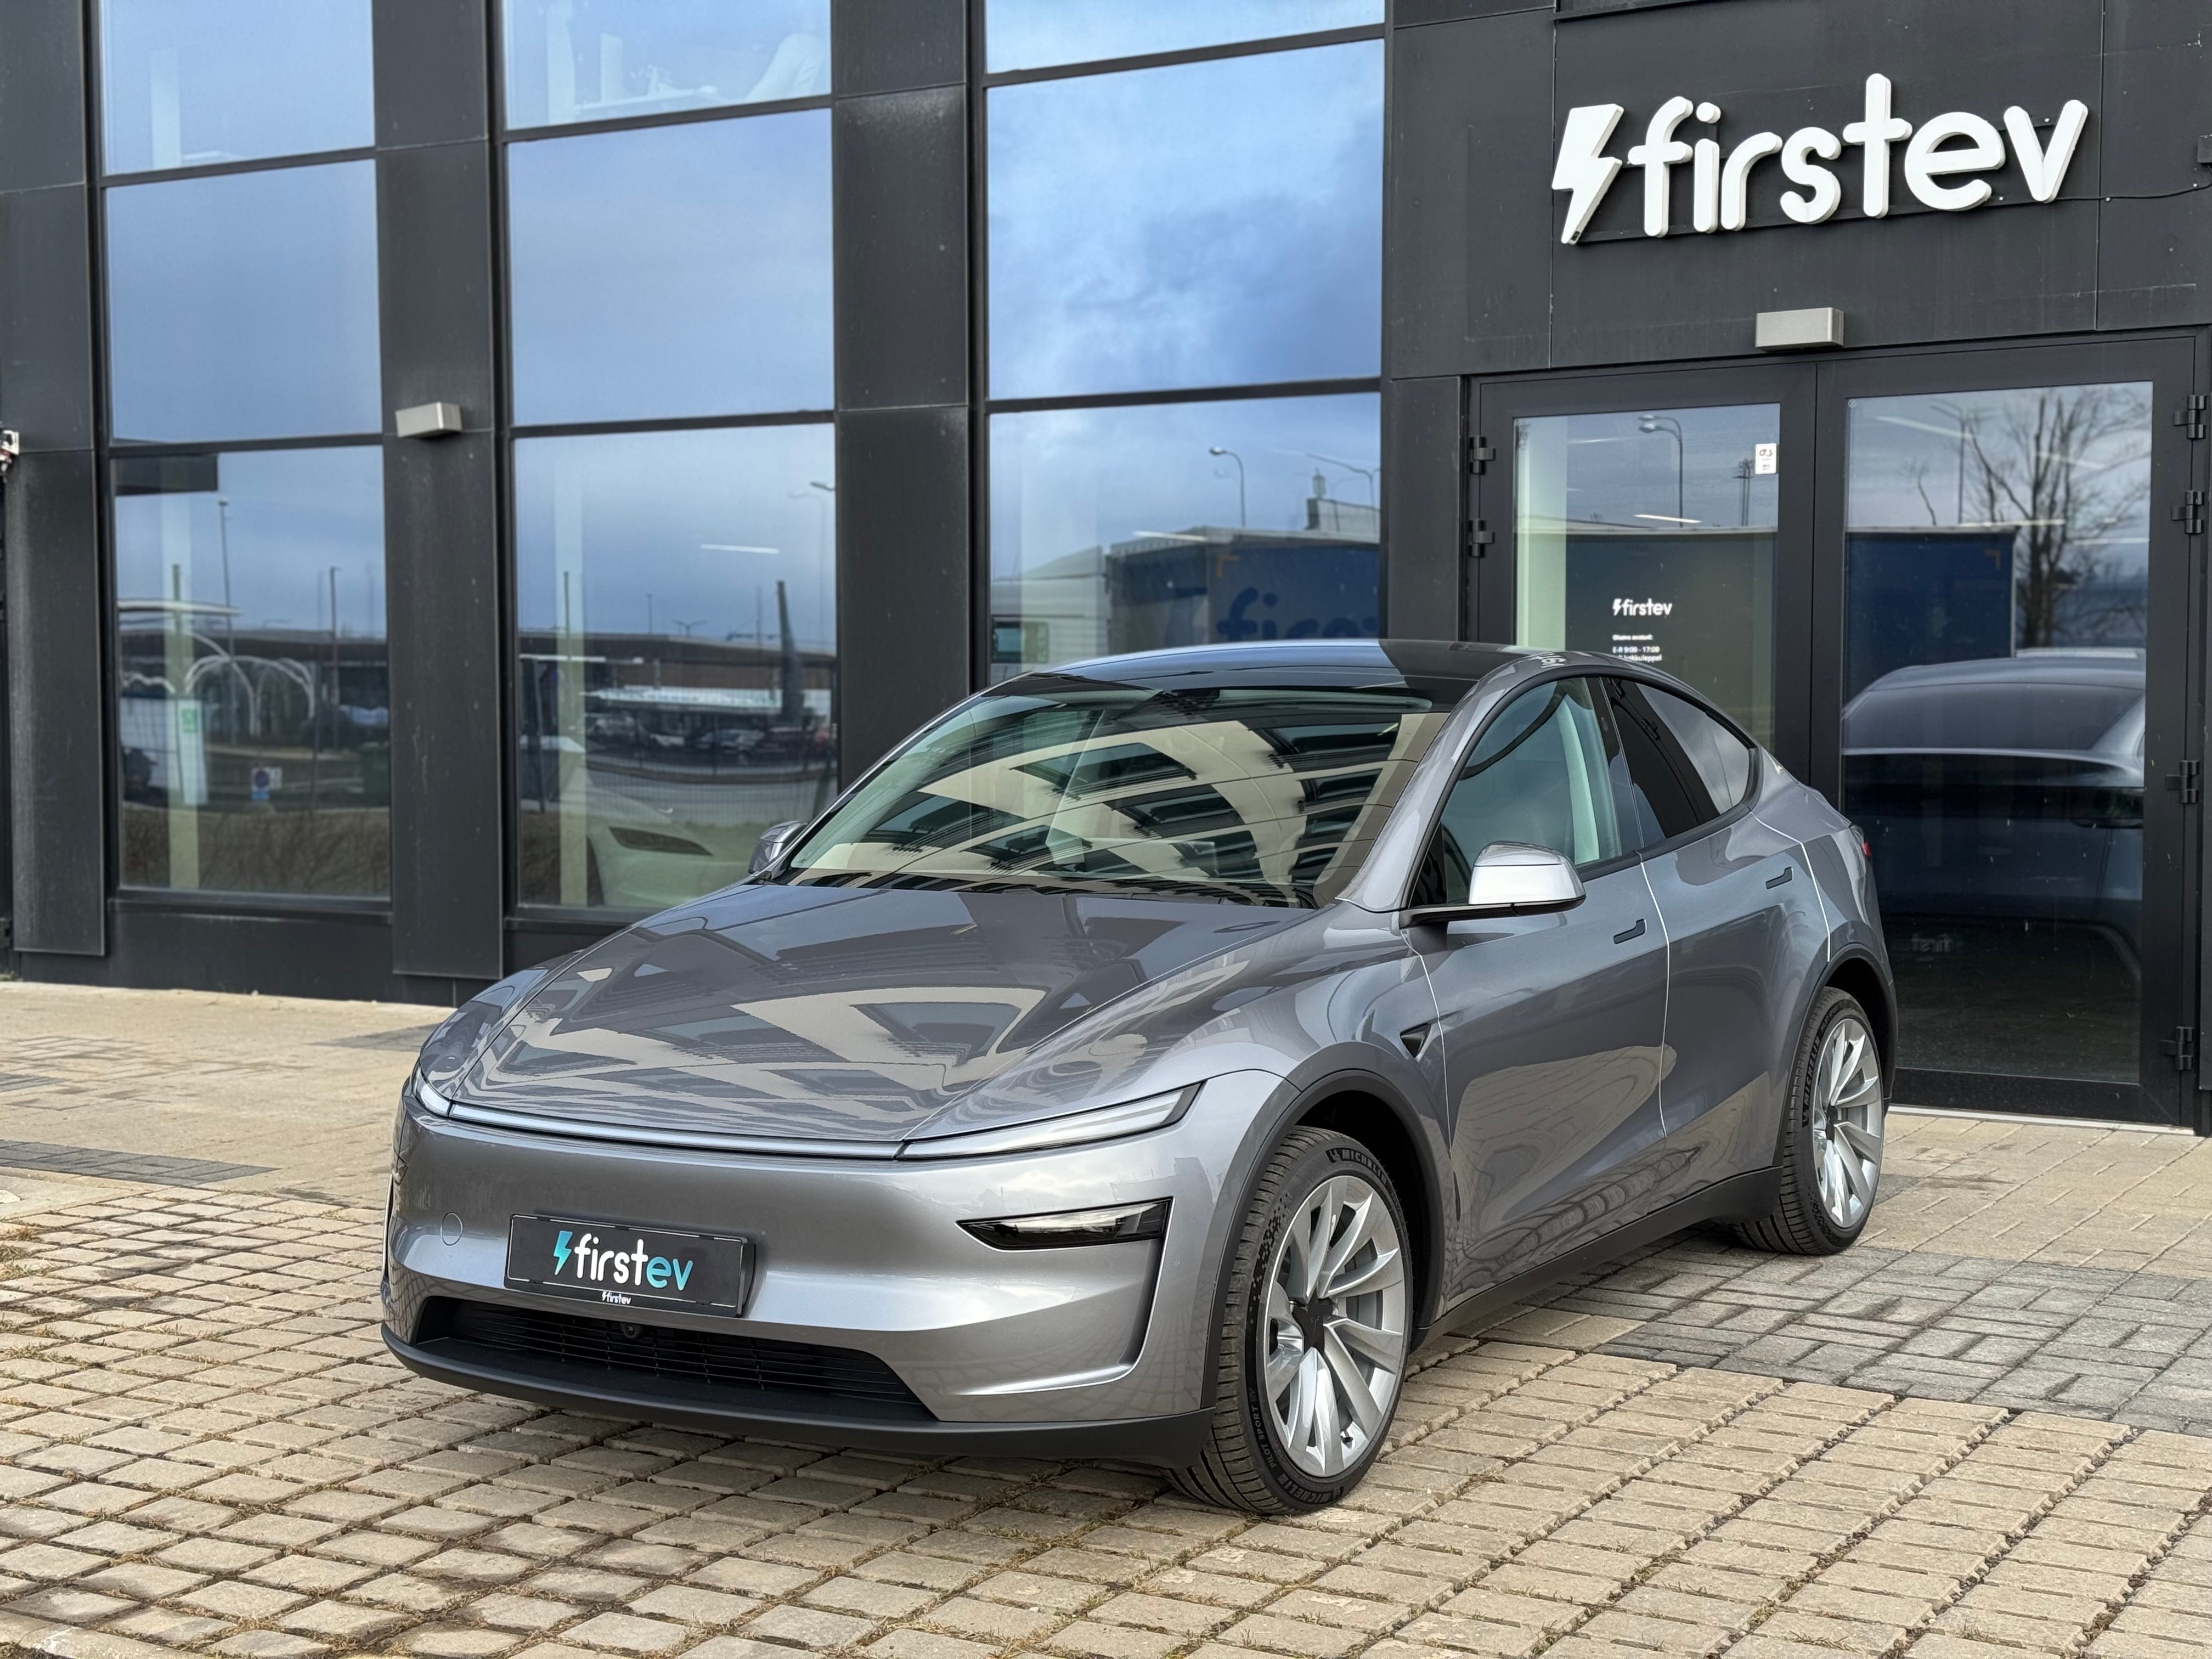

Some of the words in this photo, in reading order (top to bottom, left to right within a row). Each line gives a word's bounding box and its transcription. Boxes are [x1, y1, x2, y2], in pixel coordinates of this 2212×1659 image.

[1627, 73, 2088, 238] firstev
[1622, 597, 1673, 616] firstev
[1341, 1149, 1387, 1186] MICHELIN
[574, 1233, 693, 1291] firstev
[606, 1293, 631, 1305] firstev
[1251, 1405, 1265, 1441] SPORT
[1263, 1442, 1278, 1469] PILOT
[1277, 1473, 1331, 1503] MICHELIN
